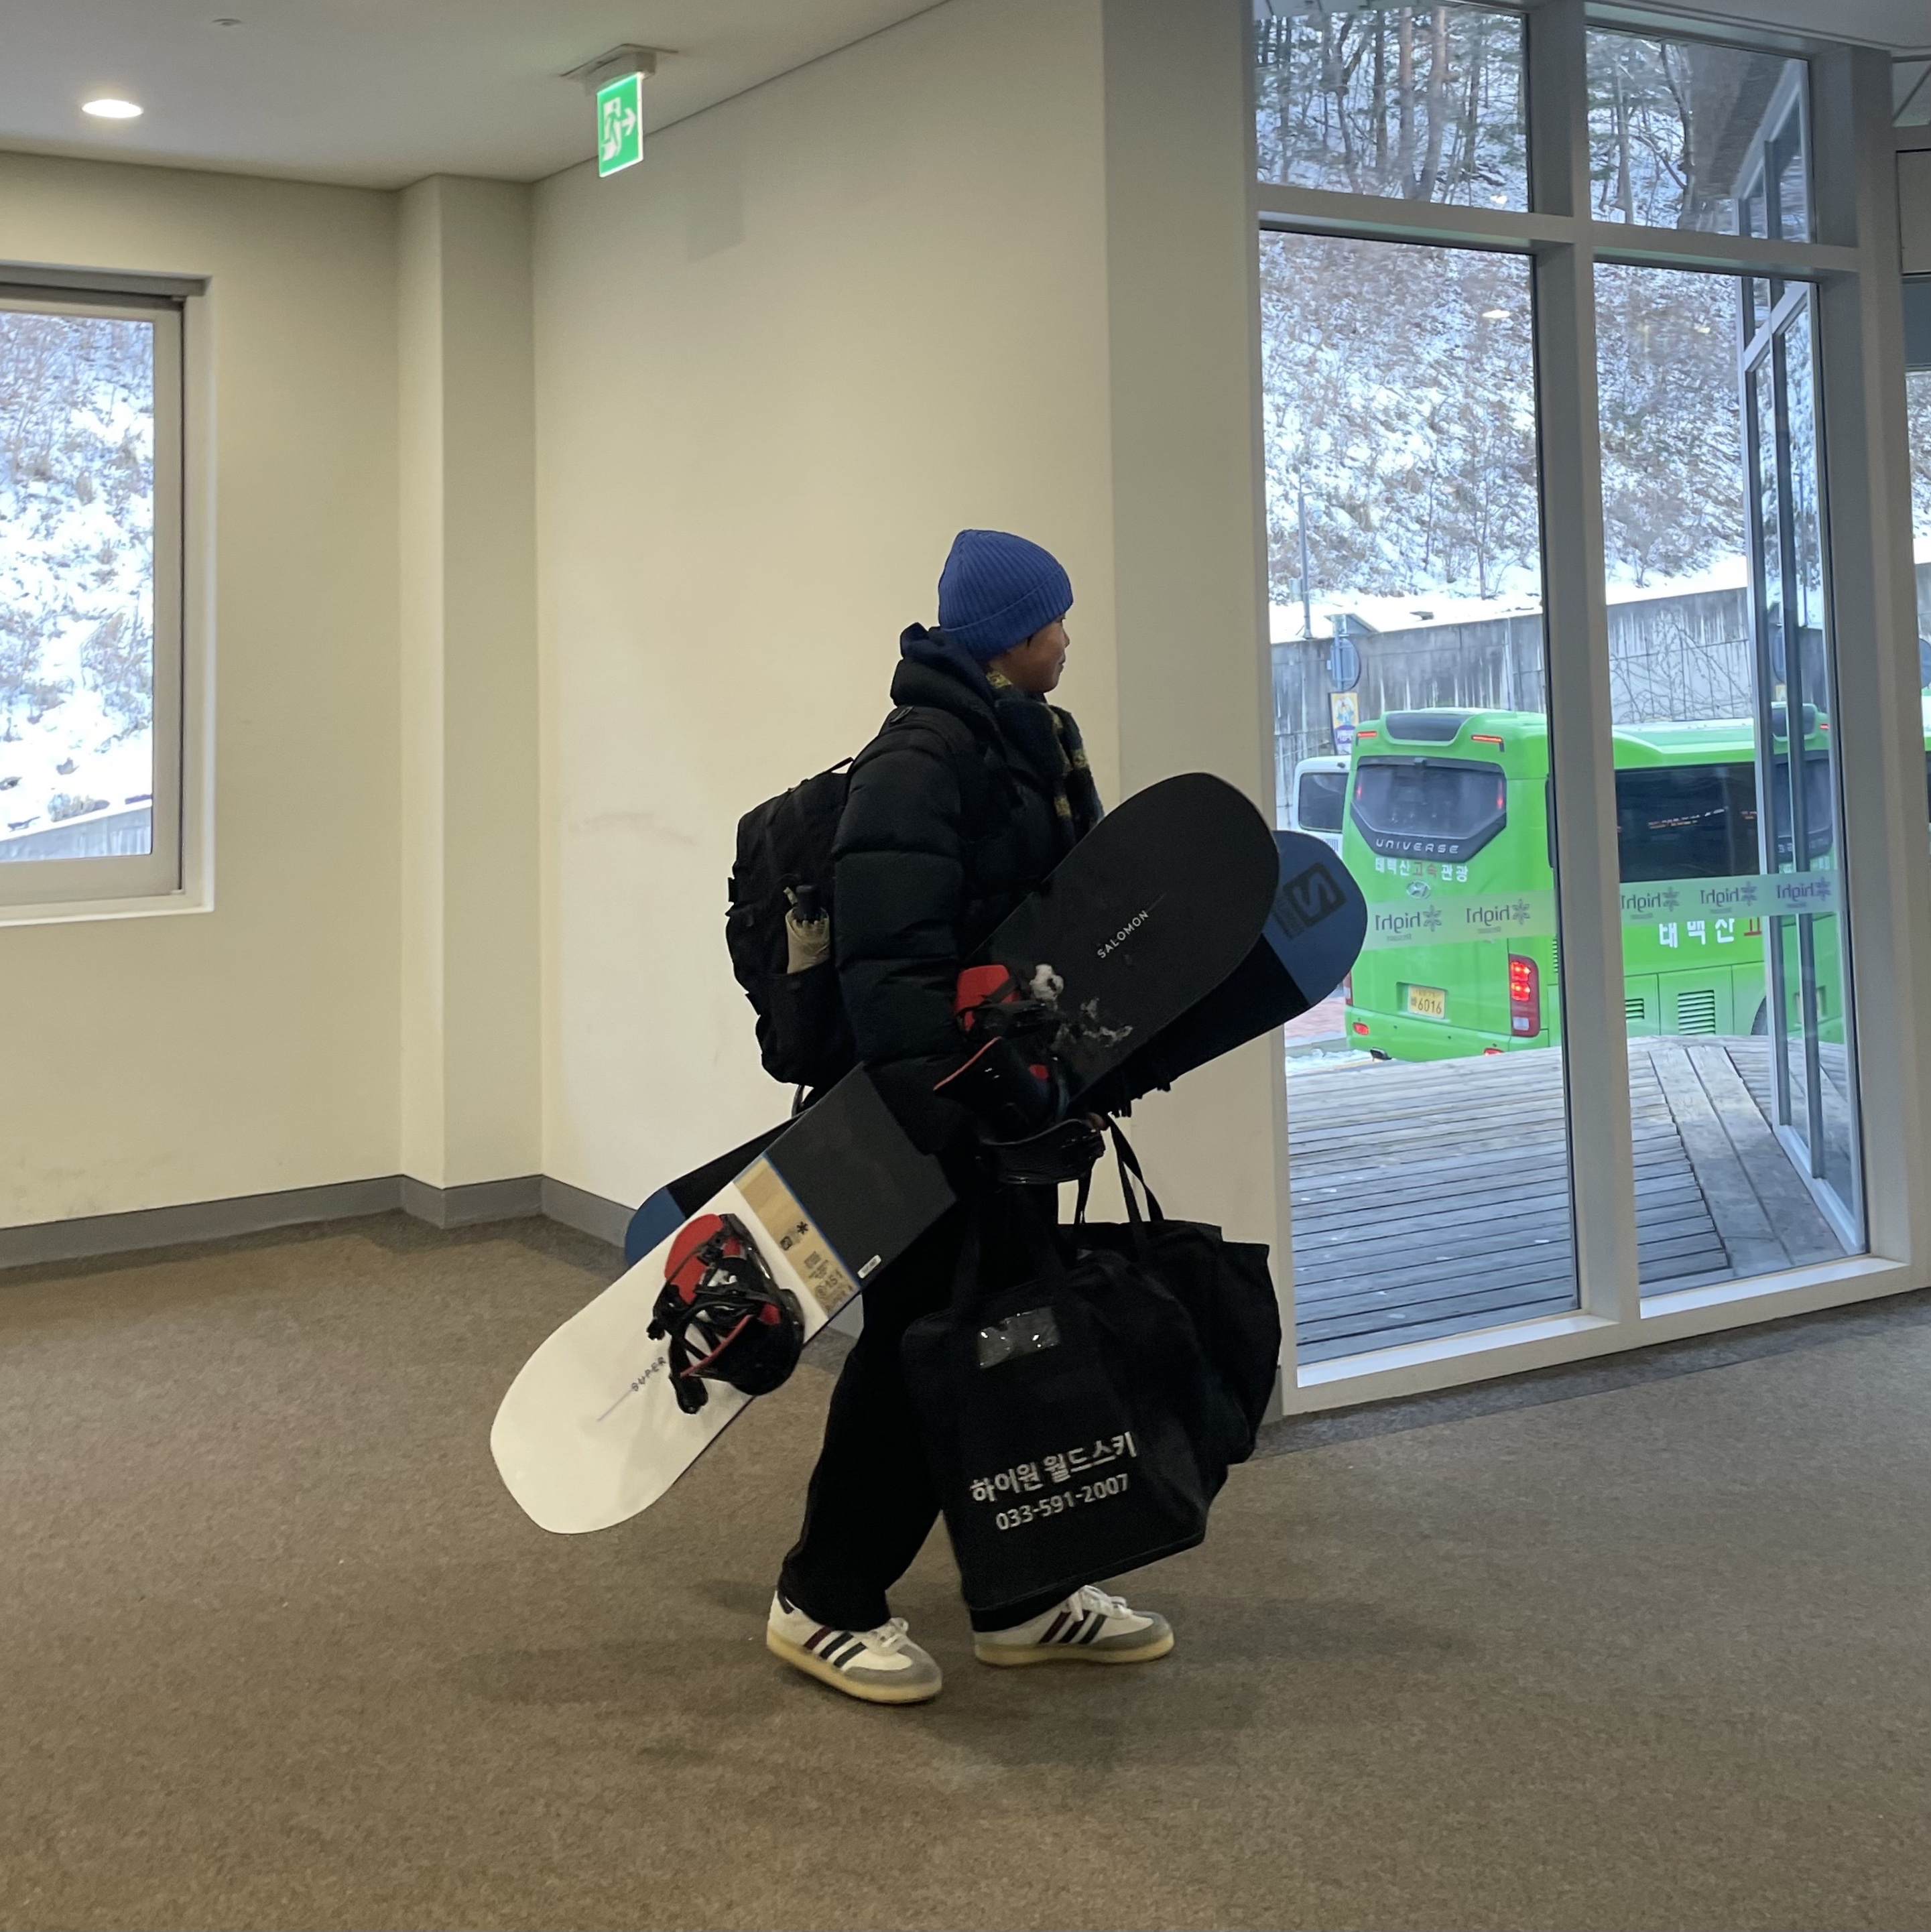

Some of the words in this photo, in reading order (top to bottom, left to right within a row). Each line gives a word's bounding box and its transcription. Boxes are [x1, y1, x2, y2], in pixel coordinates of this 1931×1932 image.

[1375, 838, 1459, 854] UNIVERSE
[1097, 910, 1149, 958] SALOMON
[631, 1356, 667, 1392] SUPER
[970, 1462, 1044, 1502] 하이원
[1043, 1431, 1137, 1483] 월드스키
[995, 1473, 1129, 1531] 033-591-2007
